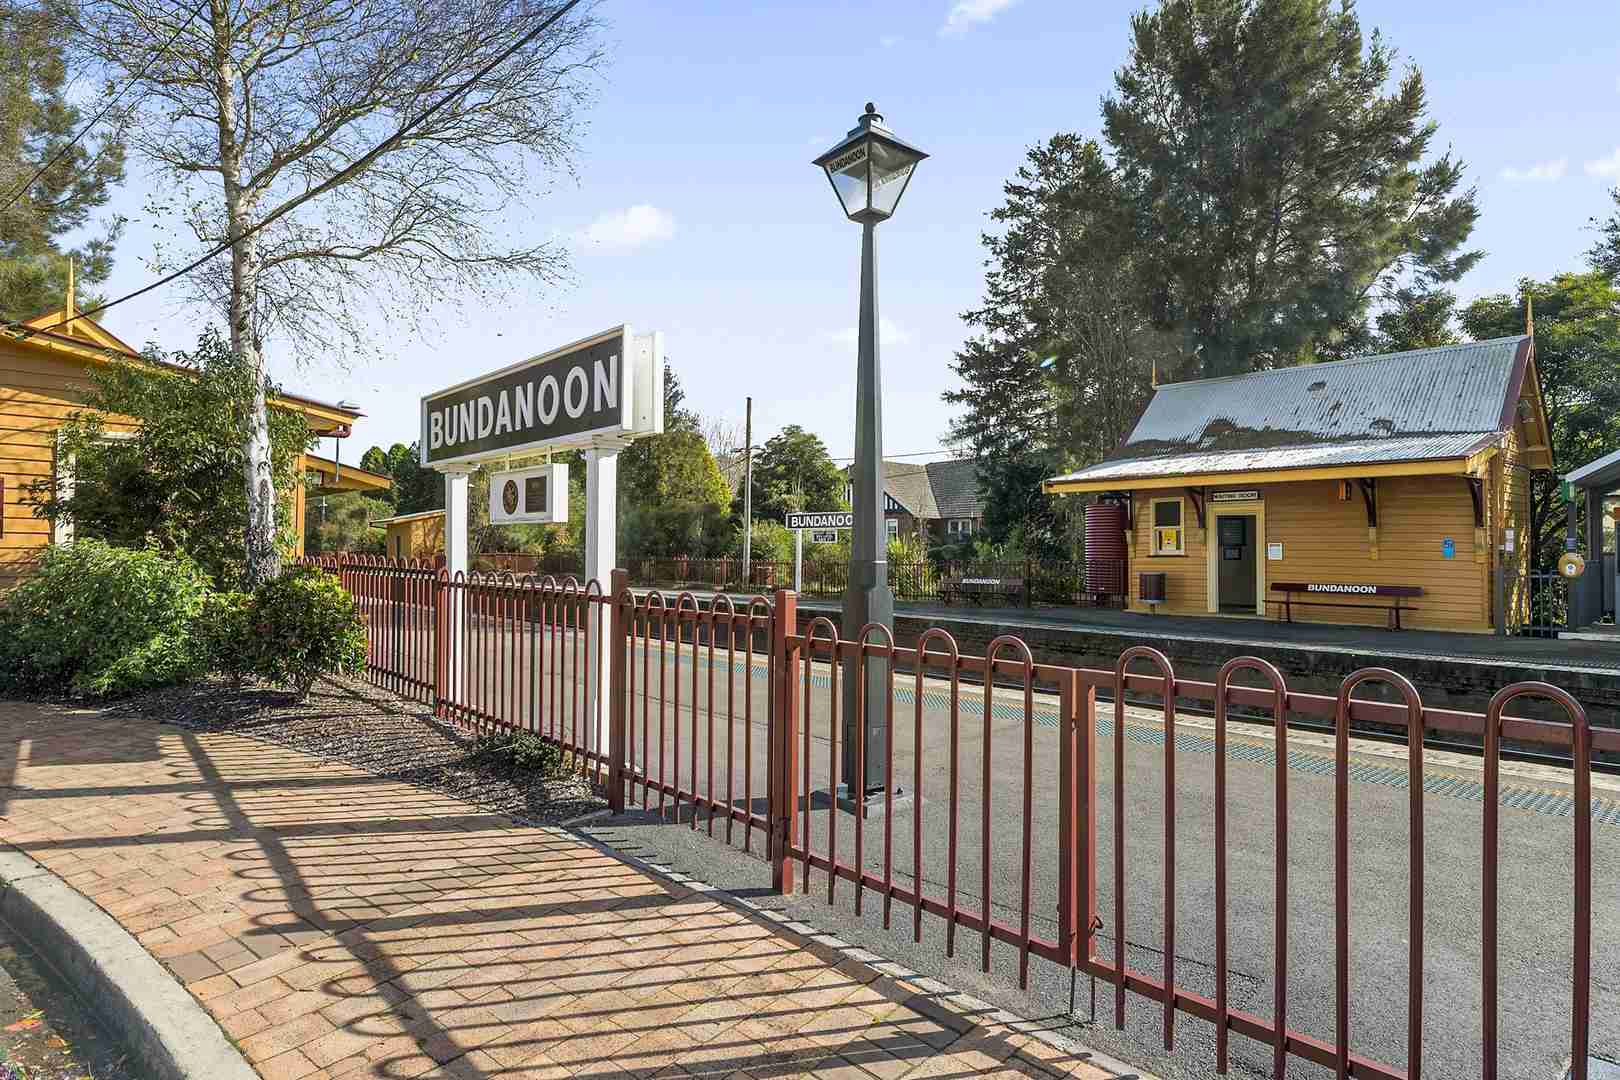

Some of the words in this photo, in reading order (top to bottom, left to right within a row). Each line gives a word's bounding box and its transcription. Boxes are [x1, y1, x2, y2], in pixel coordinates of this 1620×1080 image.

[430, 354, 618, 450] BUNDANOON
[791, 514, 853, 527] BUNDANOO
[1307, 584, 1377, 594] BUNDANOON
